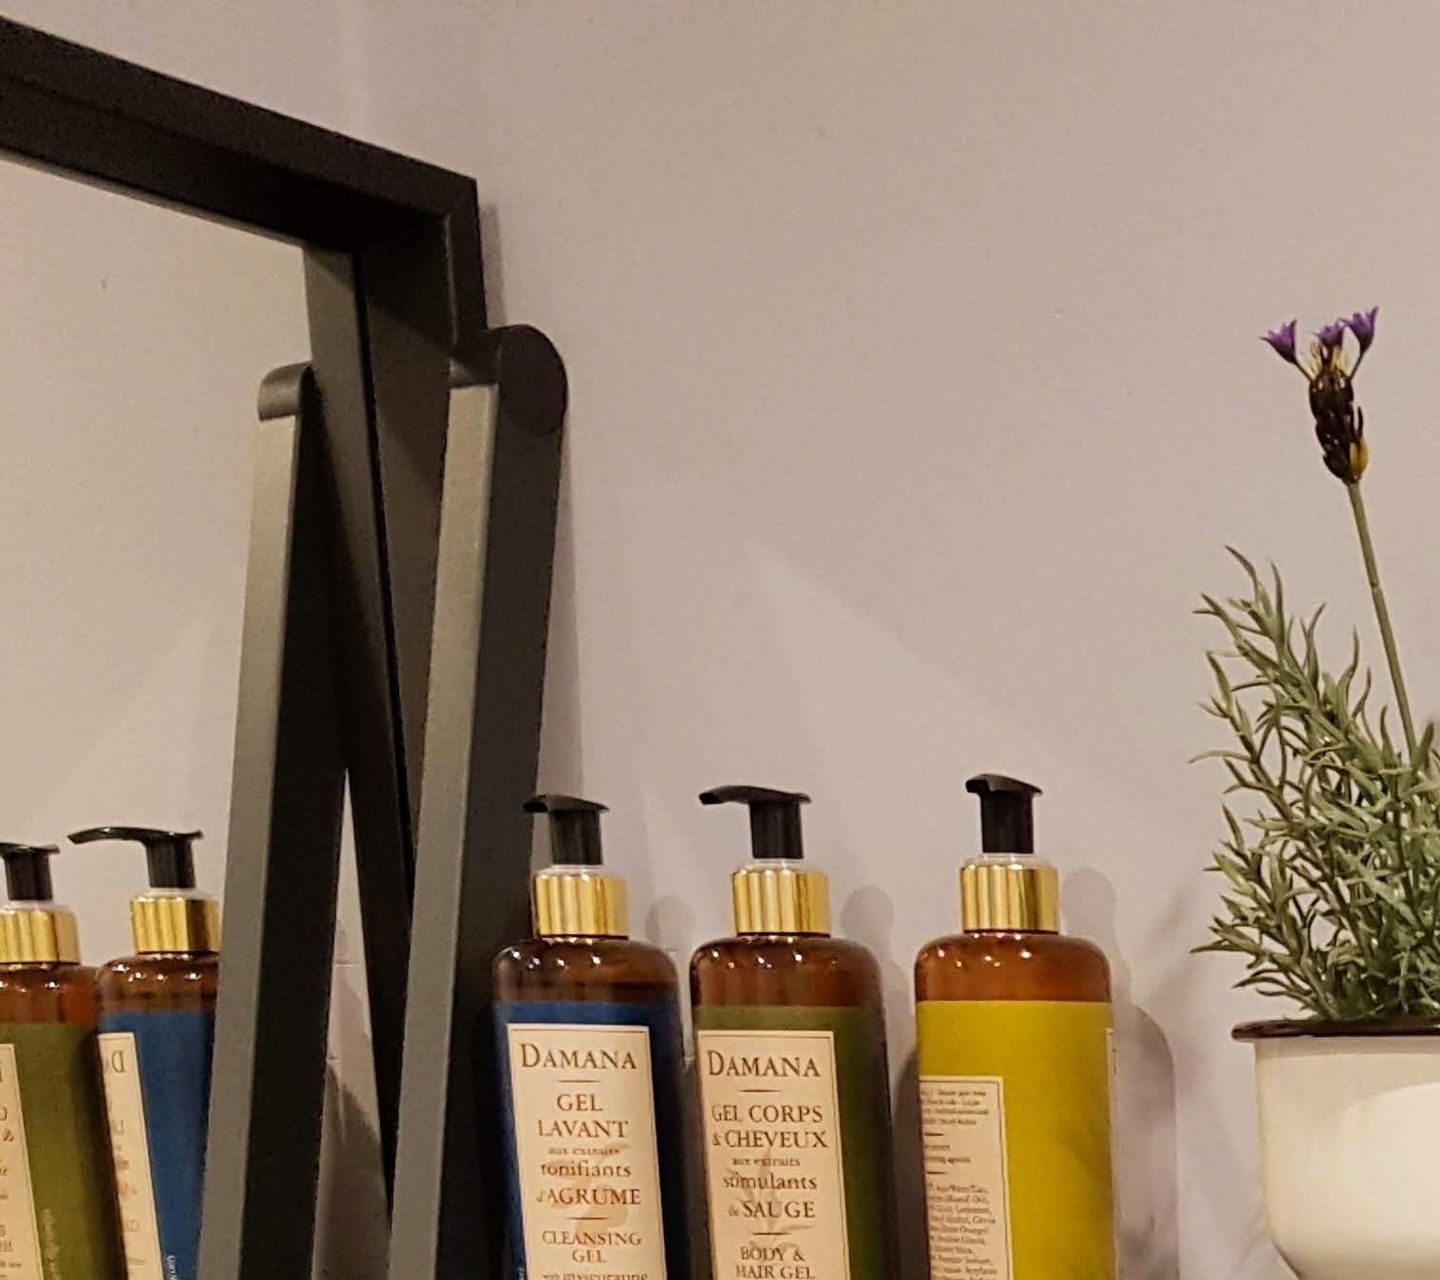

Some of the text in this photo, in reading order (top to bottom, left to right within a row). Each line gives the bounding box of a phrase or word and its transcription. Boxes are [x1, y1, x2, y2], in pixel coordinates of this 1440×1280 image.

[521, 1043, 638, 1070] DAMANA
[707, 1050, 821, 1077] DAMANA
[557, 1093, 603, 1112] GEL
[712, 1104, 823, 1123] GEL CORPS
[538, 1119, 629, 1138] LAVANT
[724, 1129, 828, 1148] CHEVEUX
[541, 1160, 631, 1177] tonifiants
[722, 1171, 817, 1190] stimulants
[742, 1201, 816, 1219] SAUGE
[542, 1230, 642, 1246] CLEANSING
[572, 1249, 607, 1263] GEL
[740, 1246, 806, 1262] BODY &
[735, 1265, 816, 1280] HAIR GEL
